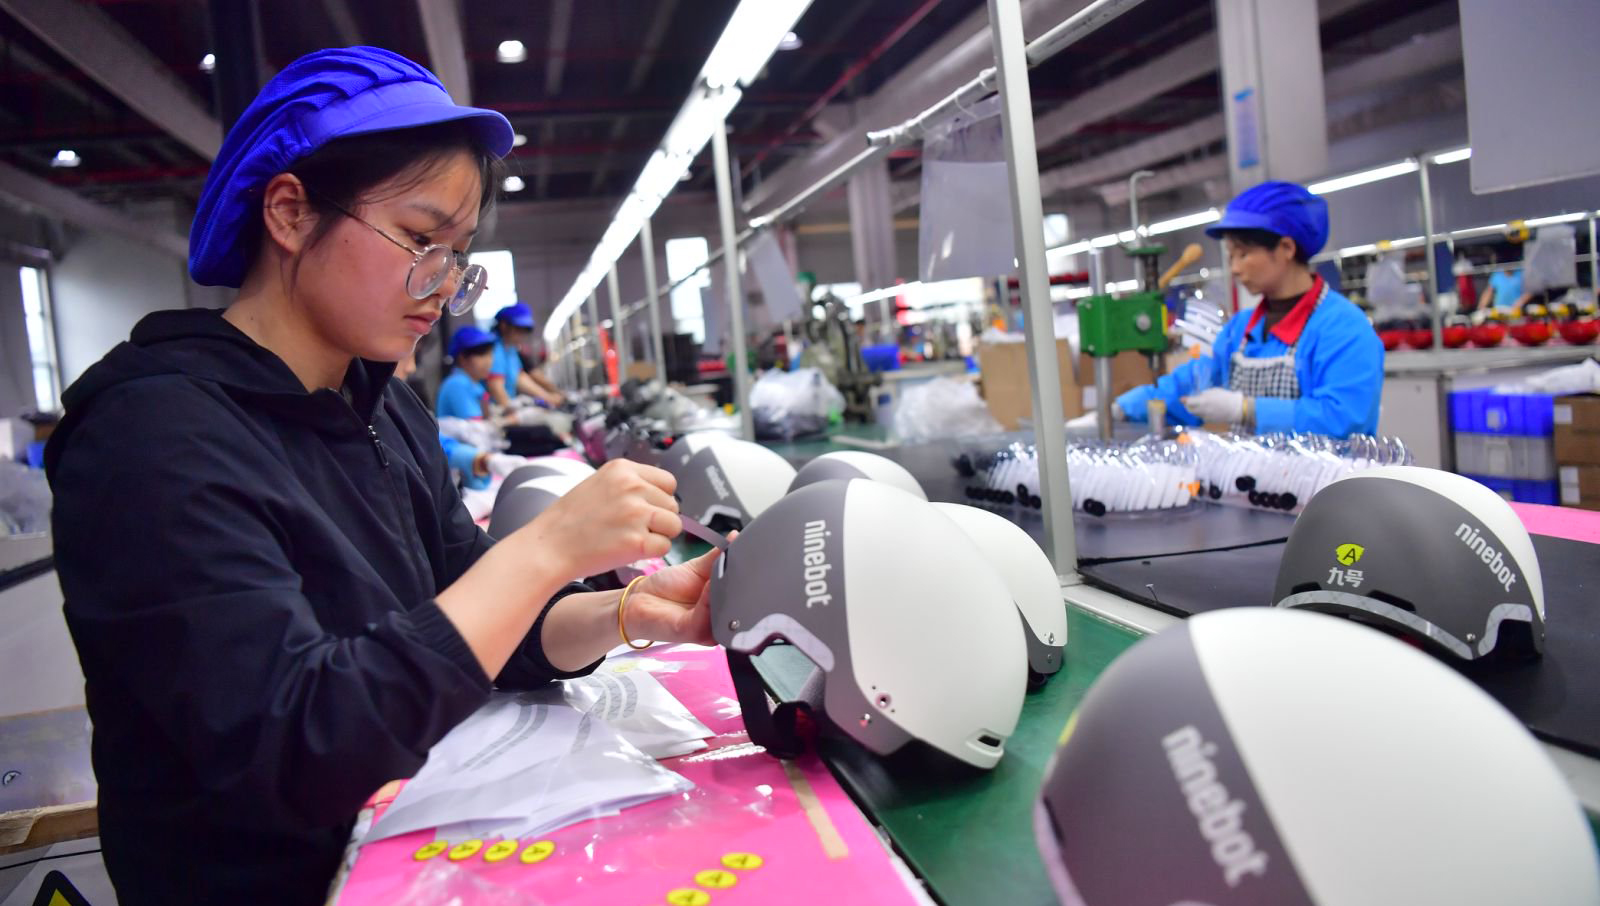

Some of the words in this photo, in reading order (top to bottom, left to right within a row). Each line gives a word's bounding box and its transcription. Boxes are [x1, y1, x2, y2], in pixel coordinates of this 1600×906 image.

[803, 519, 832, 608] ninebot
[1326, 566, 1364, 588] 九号
[1342, 548, 1356, 563] A
[1454, 522, 1516, 593] ninebot
[1161, 724, 1269, 888] ninebot
